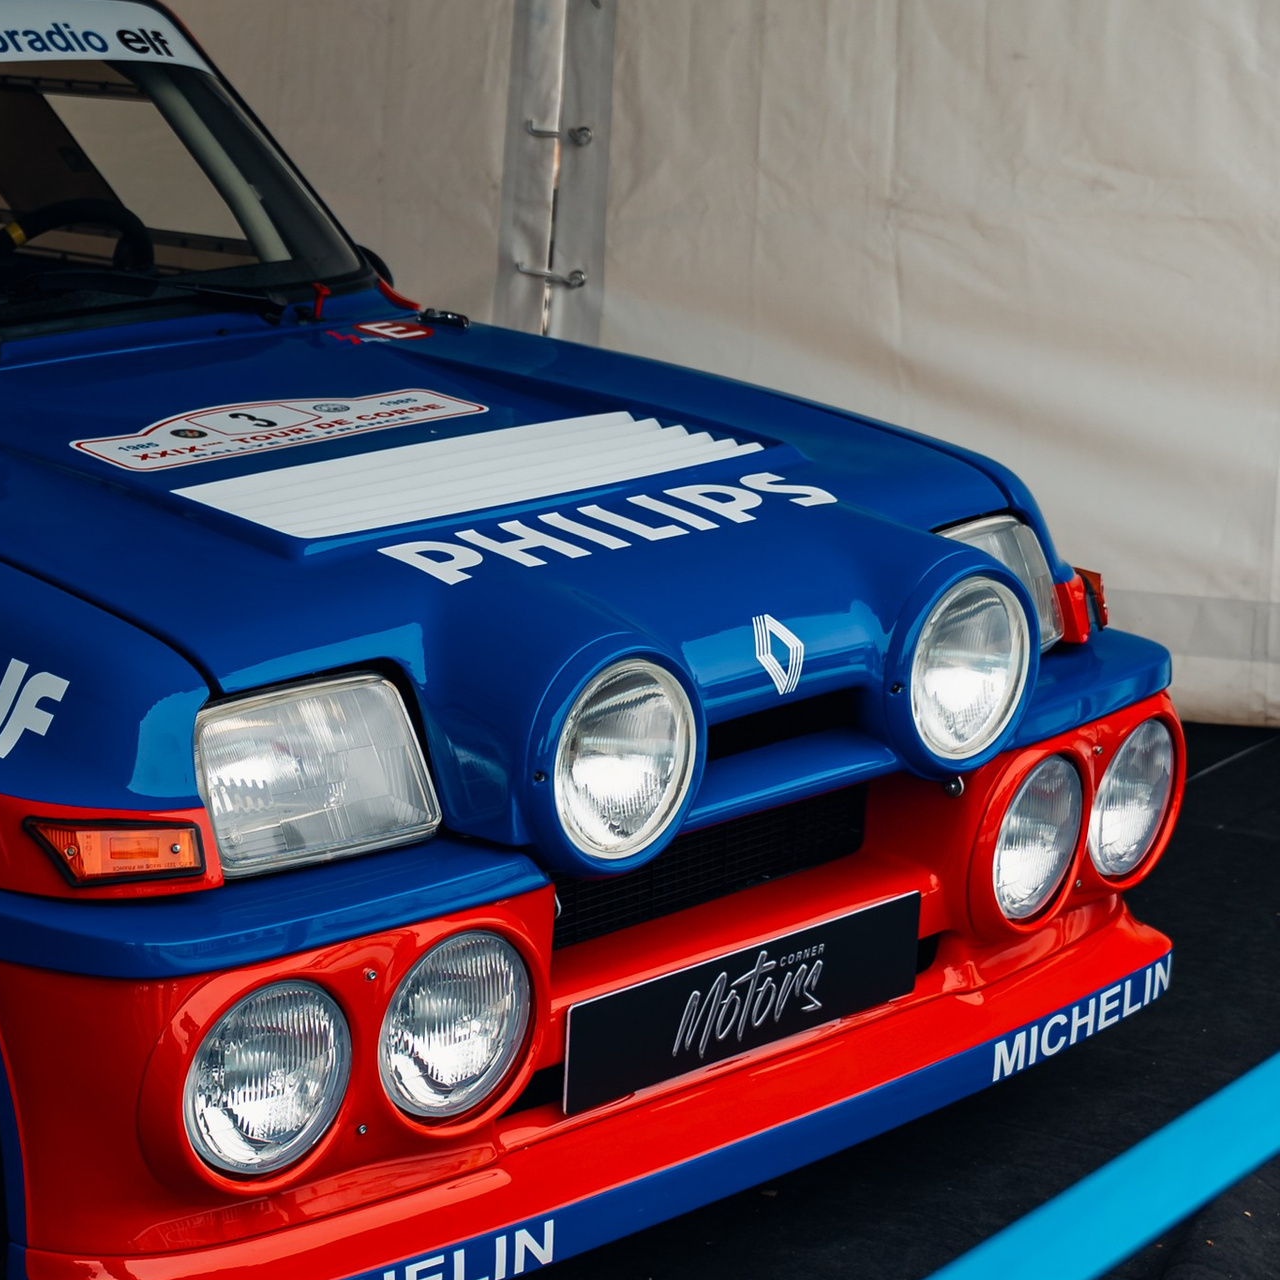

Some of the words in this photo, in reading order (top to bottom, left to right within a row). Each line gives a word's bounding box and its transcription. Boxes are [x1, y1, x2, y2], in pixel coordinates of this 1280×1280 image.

[116, 29, 174, 57] elf
[193, 440, 280, 458] RALLYE
[288, 433, 318, 442] DE
[324, 415, 413, 435] FRANCE
[228, 412, 277, 428] 3
[230, 427, 312, 444] TOUR
[314, 418, 354, 429] DE
[356, 403, 446, 421] CORSE
[118, 441, 159, 452] 1985
[376, 472, 838, 586] PHILIPS
[779, 943, 825, 967] CORNER
[671, 950, 823, 1059] Motors
[991, 953, 1172, 1082] MICHELIN
